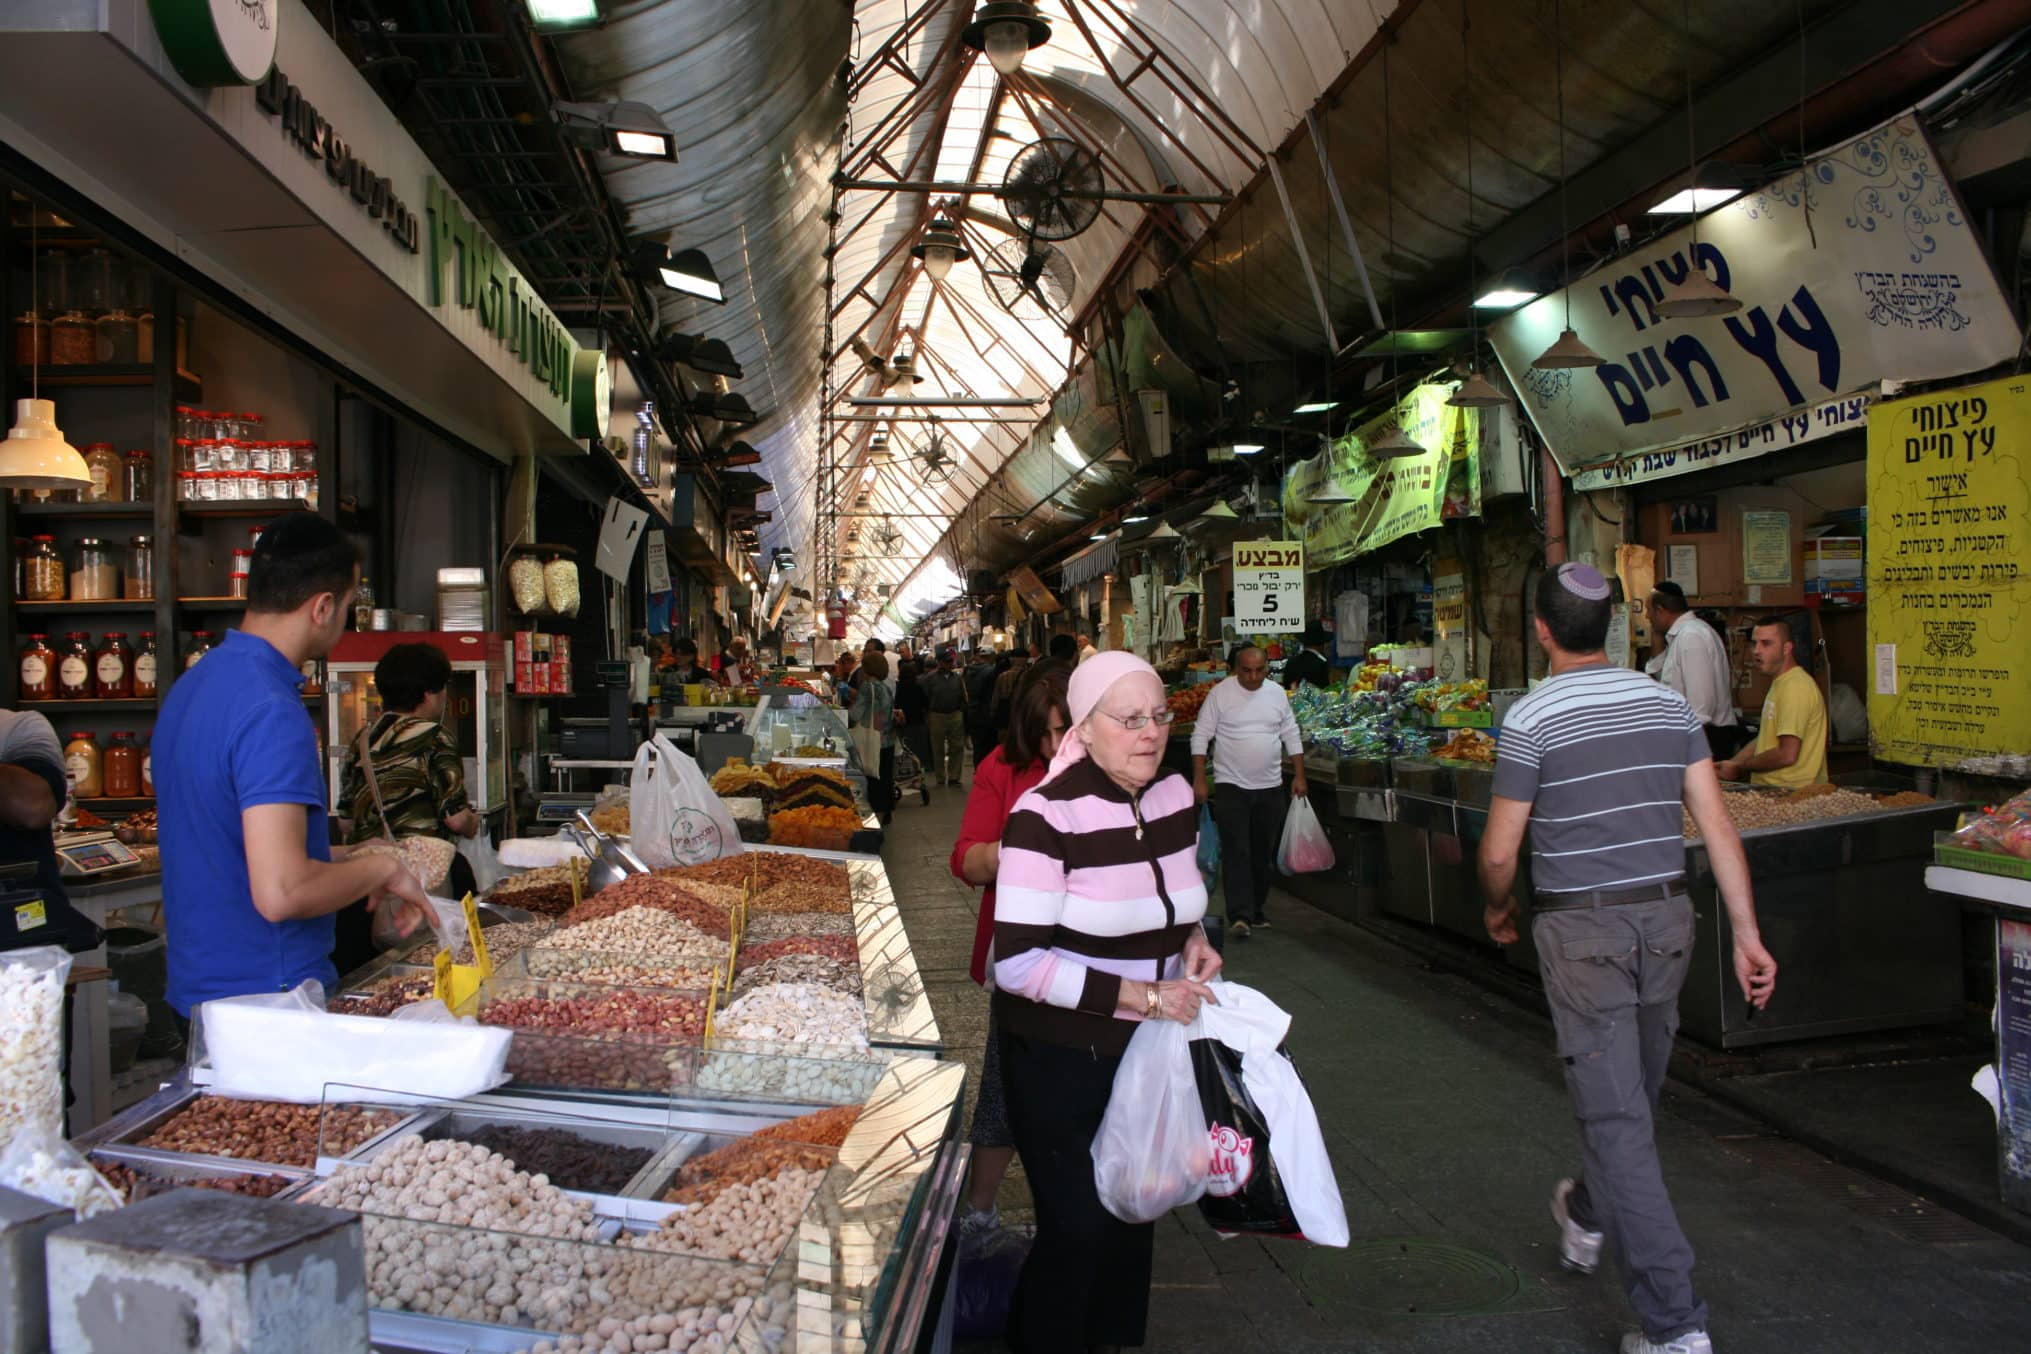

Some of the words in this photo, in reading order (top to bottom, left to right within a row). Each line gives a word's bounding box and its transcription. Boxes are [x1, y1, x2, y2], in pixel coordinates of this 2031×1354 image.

[1901, 273, 1961, 288] בהשגחת
[1722, 284, 1841, 407] עץ
[1594, 334, 1731, 427] חיים
[1911, 397, 1987, 432] פיצוחי
[1738, 423, 1775, 449] חיים
[1781, 413, 1809, 443] עץ
[1905, 433, 1953, 463] חיים
[1962, 425, 1995, 462] עץ
[1642, 450, 1676, 473] שבת
[1927, 472, 1968, 492] אישור
[1891, 513, 1902, 528] כי
[1906, 512, 1927, 527] בזה
[1931, 507, 1981, 525] מאשרים
[1985, 505, 2007, 521] אנו
[1884, 566, 1933, 582] ותבלינים
[1938, 565, 1975, 581] יבשים
[1980, 563, 2018, 580] פירות
[1262, 581, 1280, 591] יבול
[1284, 582, 1301, 592] ירק
[1262, 593, 1279, 613] 5
[1901, 593, 1935, 608] בחנות
[1939, 592, 1992, 608] הנמכרים
[1240, 617, 1276, 627] ליחידה
